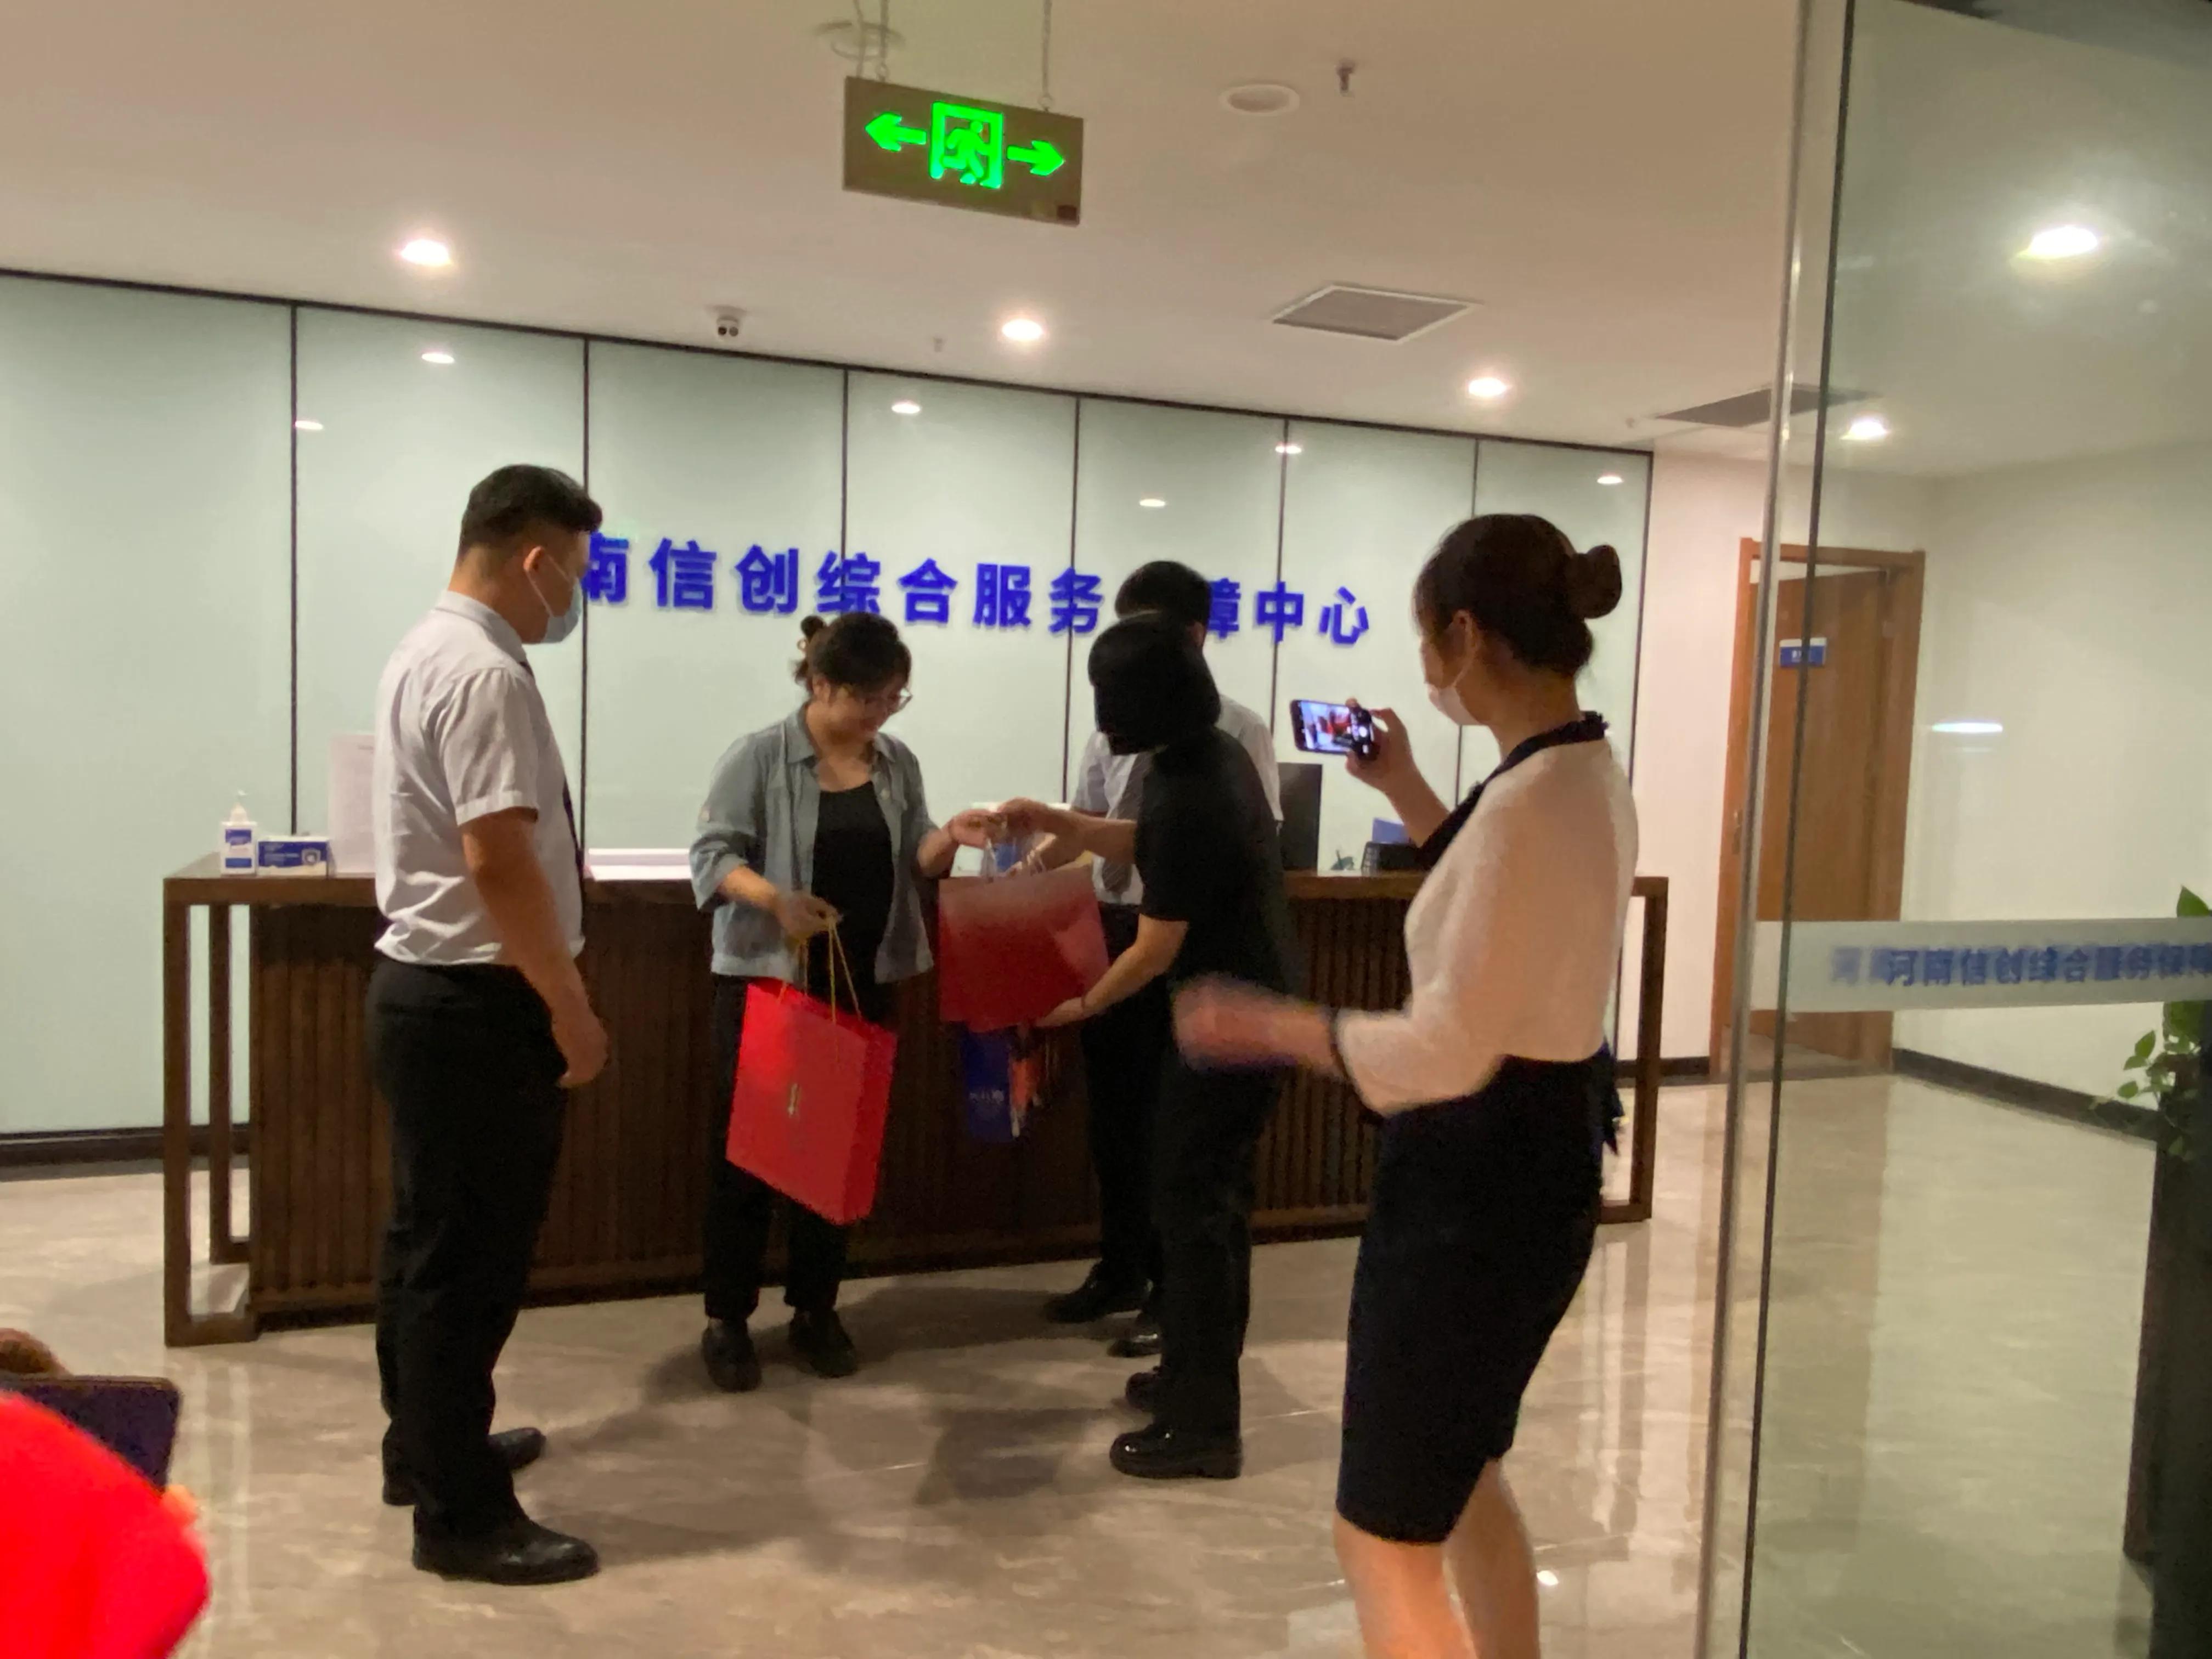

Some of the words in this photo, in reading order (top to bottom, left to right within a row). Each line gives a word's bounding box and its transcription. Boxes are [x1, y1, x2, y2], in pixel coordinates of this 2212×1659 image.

[582, 531, 1369, 645] 南信创综合服务障中心
